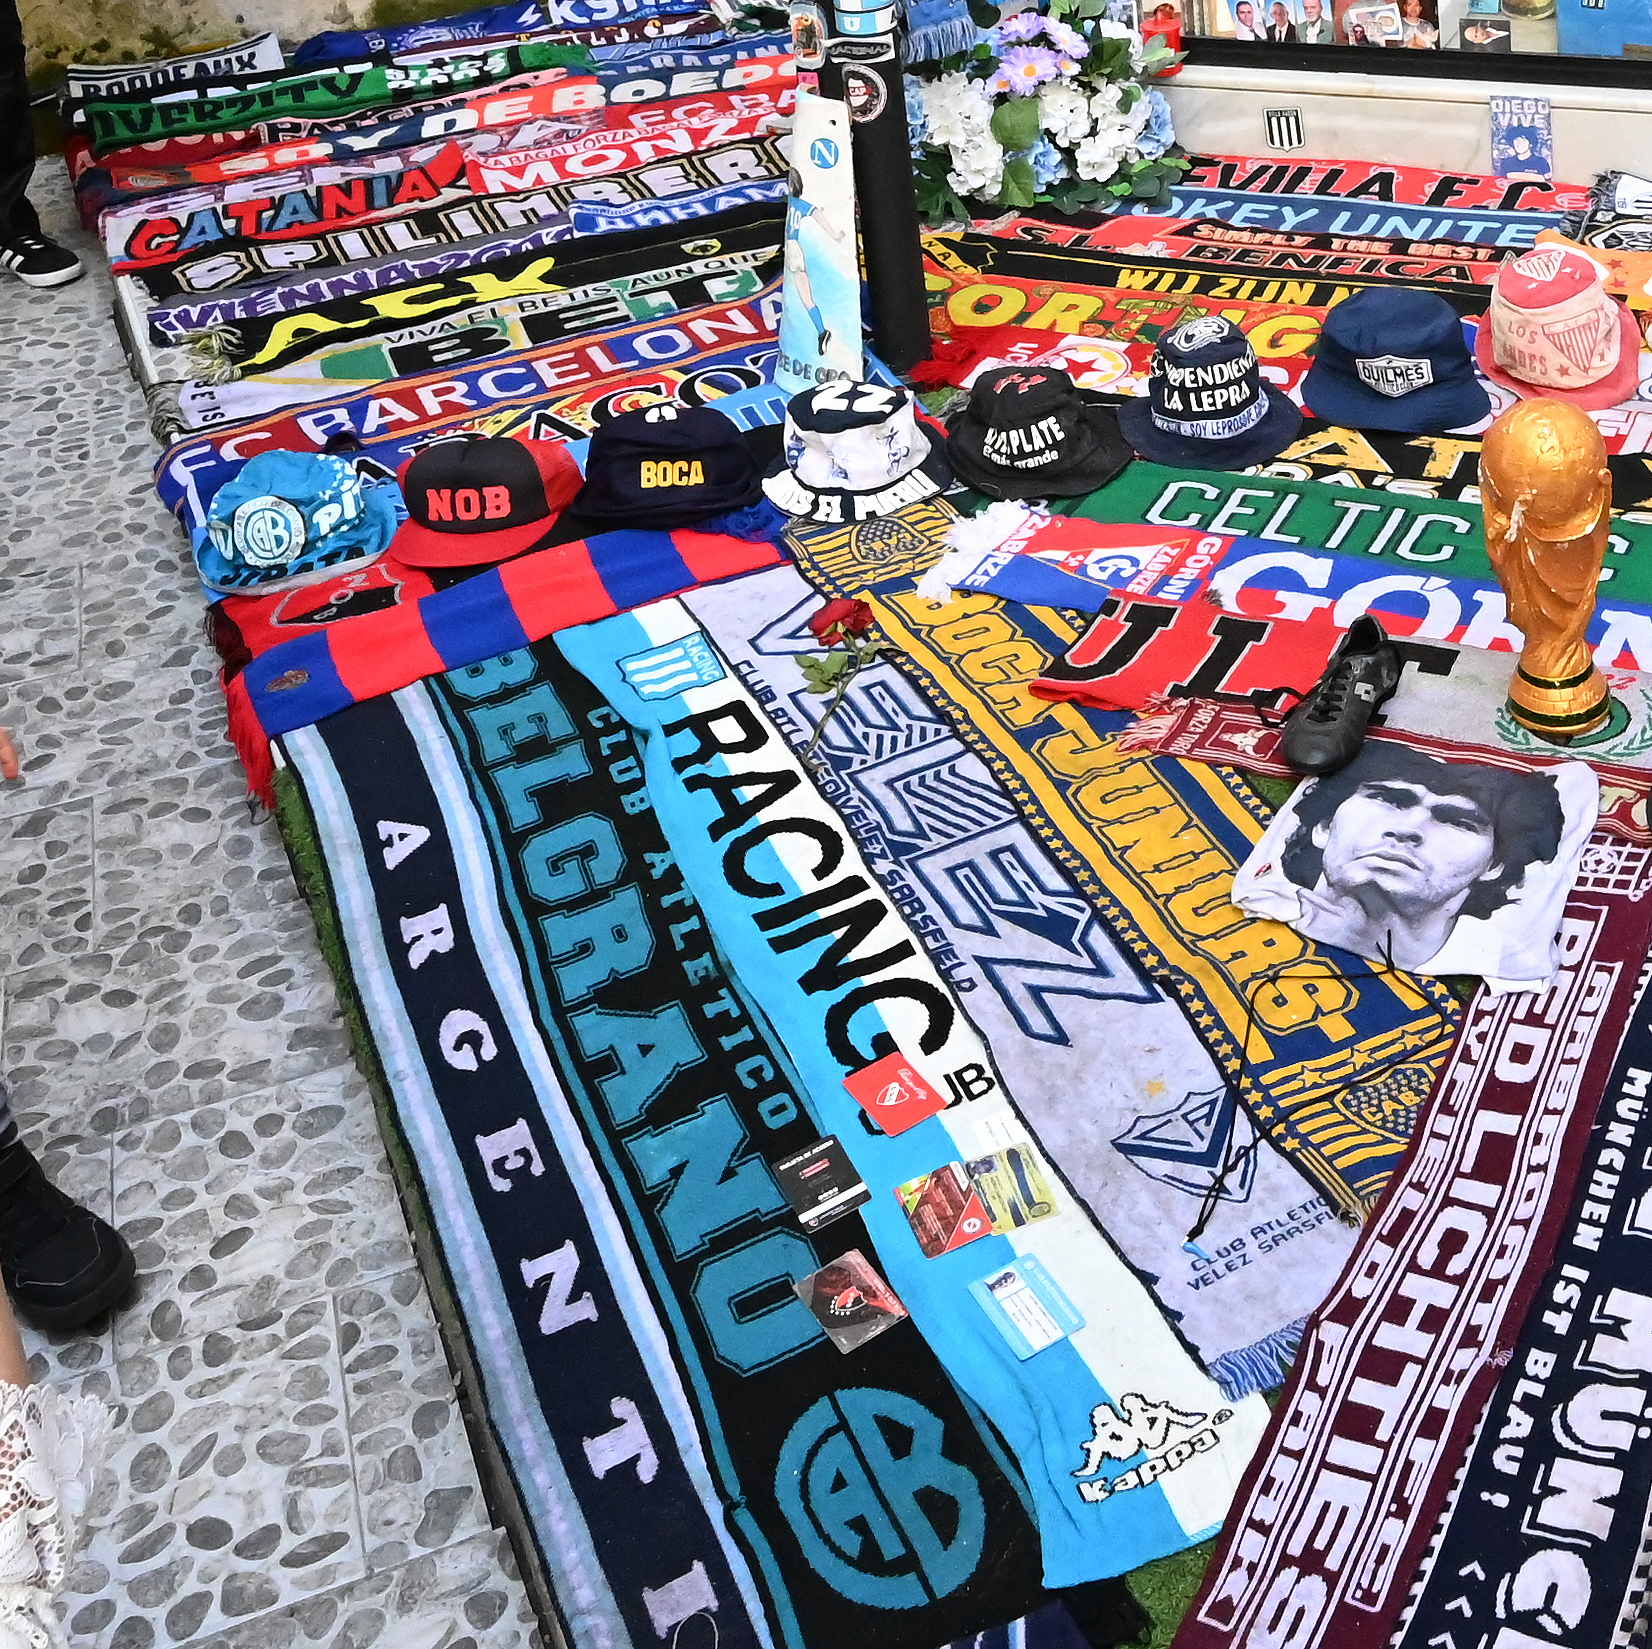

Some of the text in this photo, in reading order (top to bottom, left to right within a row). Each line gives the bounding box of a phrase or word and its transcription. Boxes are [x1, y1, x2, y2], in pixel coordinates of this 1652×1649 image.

[421, 95, 535, 138] DE
[1492, 100, 1549, 114] DIEGO
[1499, 113, 1545, 127] VIVE
[125, 166, 439, 259] CATANIA
[1192, 224, 1493, 261] SIMPLY THE BEST
[1180, 243, 1476, 283] BENFICA
[385, 320, 456, 345] VIVA
[631, 268, 698, 295] AUN
[708, 248, 771, 277] QUE
[1116, 268, 1317, 306] WIJ ZIJN
[1507, 323, 1538, 339] LOS
[296, 297, 786, 445] BARCELONA
[1358, 361, 1427, 385] QUILMES
[811, 381, 896, 414] 22
[1164, 379, 1251, 413] LA LEPRA
[641, 460, 704, 488] BOCA
[427, 486, 511, 521] NOB
[1146, 479, 1472, 563] CELTIC
[682, 634, 724, 683] RACING
[661, 700, 963, 1079] RACING
[586, 706, 802, 1133] CLUB ATLETICO
[444, 649, 833, 1379] BELGRANO
[1186, 1241, 1251, 1274] CLUB
[1186, 1257, 1254, 1295] VELEZ
[1499, 1065, 1652, 1451] MÜNCHEN IST BLAU
[1261, 1112, 1521, 1649] LICHTIES
[1077, 1428, 1221, 1504] Kappa
